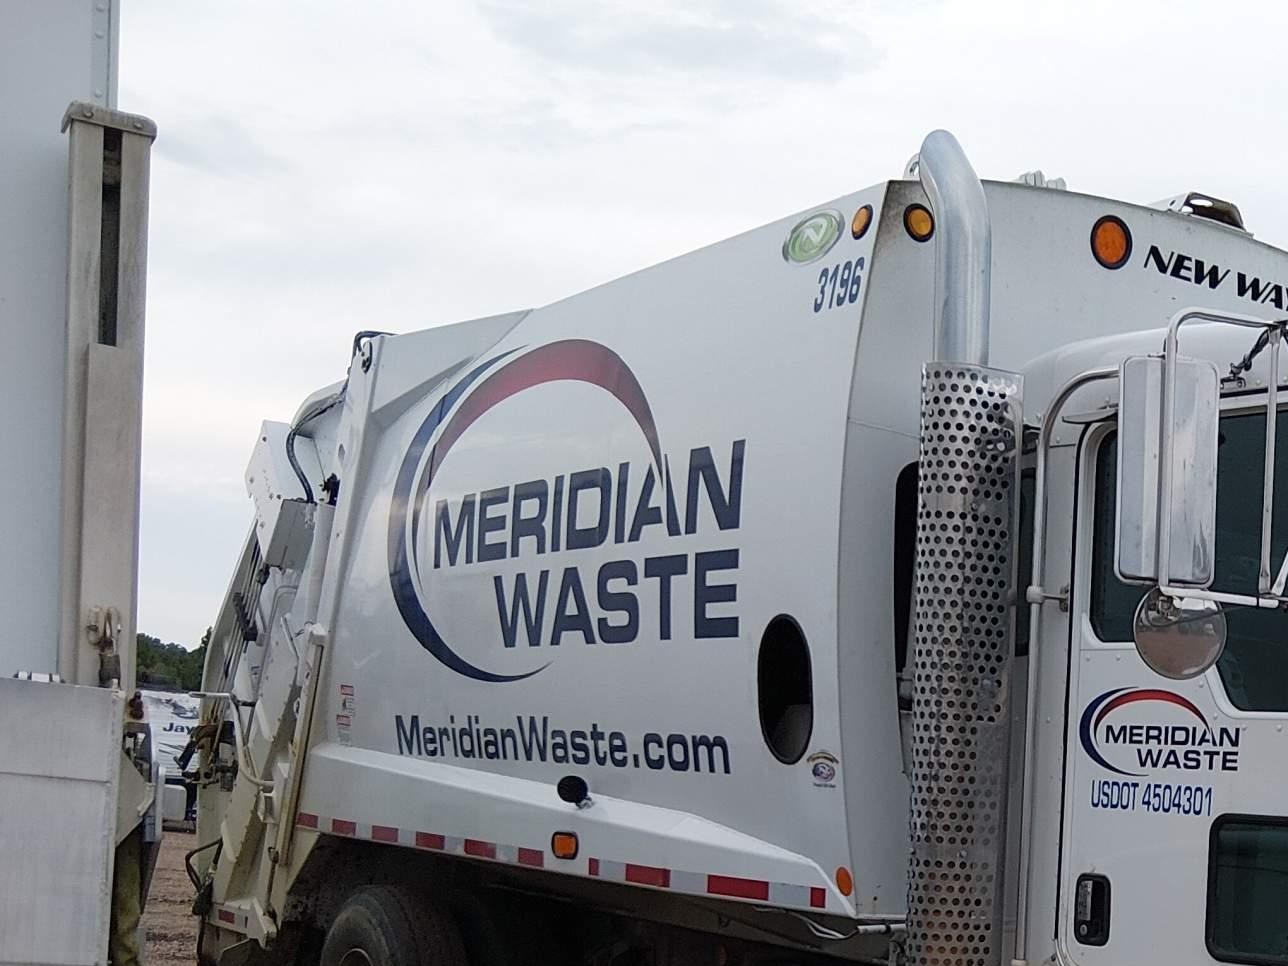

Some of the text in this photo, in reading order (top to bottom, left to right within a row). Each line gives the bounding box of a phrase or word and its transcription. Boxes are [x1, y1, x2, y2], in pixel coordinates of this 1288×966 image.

[814, 256, 864, 313] 3196
[1143, 244, 1231, 290] NEW
[433, 439, 746, 569] MERIDIAN
[493, 548, 740, 648] WASTE
[395, 714, 732, 775] MeridianWaste.com
[1105, 724, 1240, 748] MERIDIAN
[1137, 748, 1239, 771] WASTE
[1091, 779, 1212, 817] USDOT 4504301
